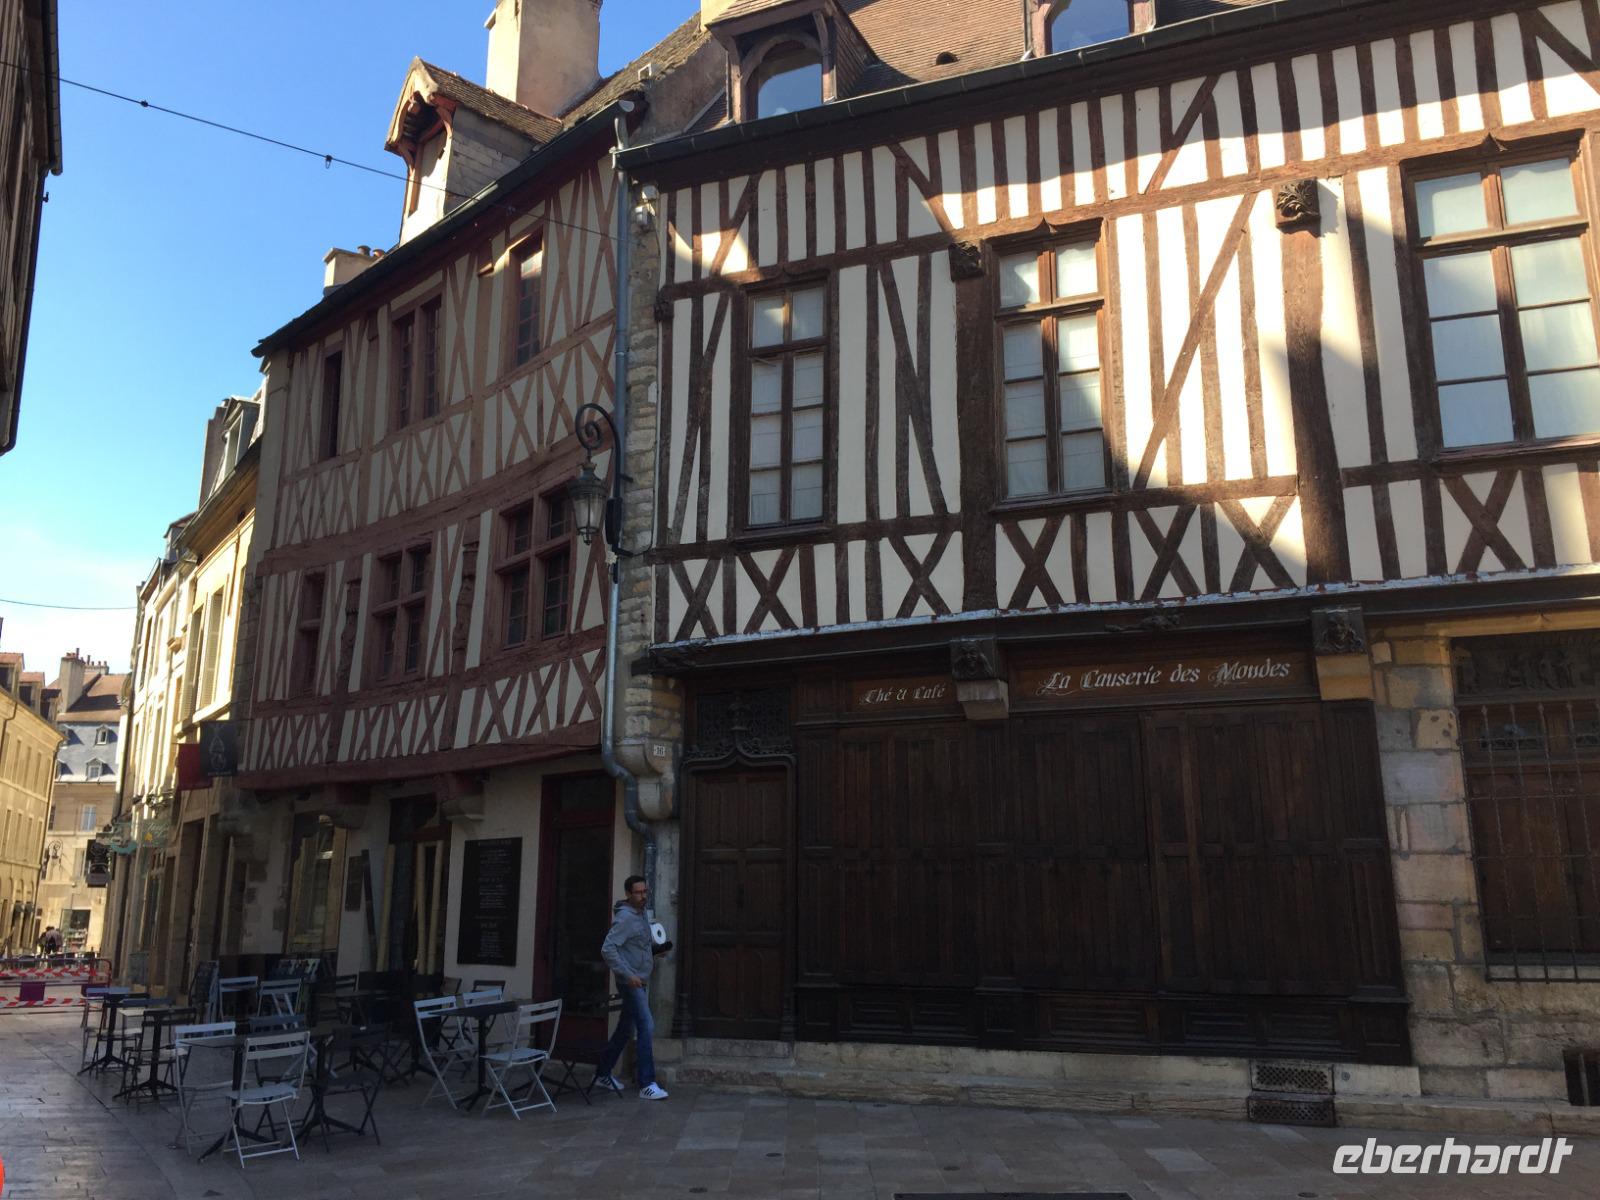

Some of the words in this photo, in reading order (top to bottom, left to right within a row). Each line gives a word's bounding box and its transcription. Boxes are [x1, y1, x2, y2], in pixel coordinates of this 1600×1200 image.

[1036, 672, 1076, 696] La
[1080, 665, 1161, 690] Causerie
[1169, 664, 1201, 683] des
[1209, 658, 1291, 687] Mondes
